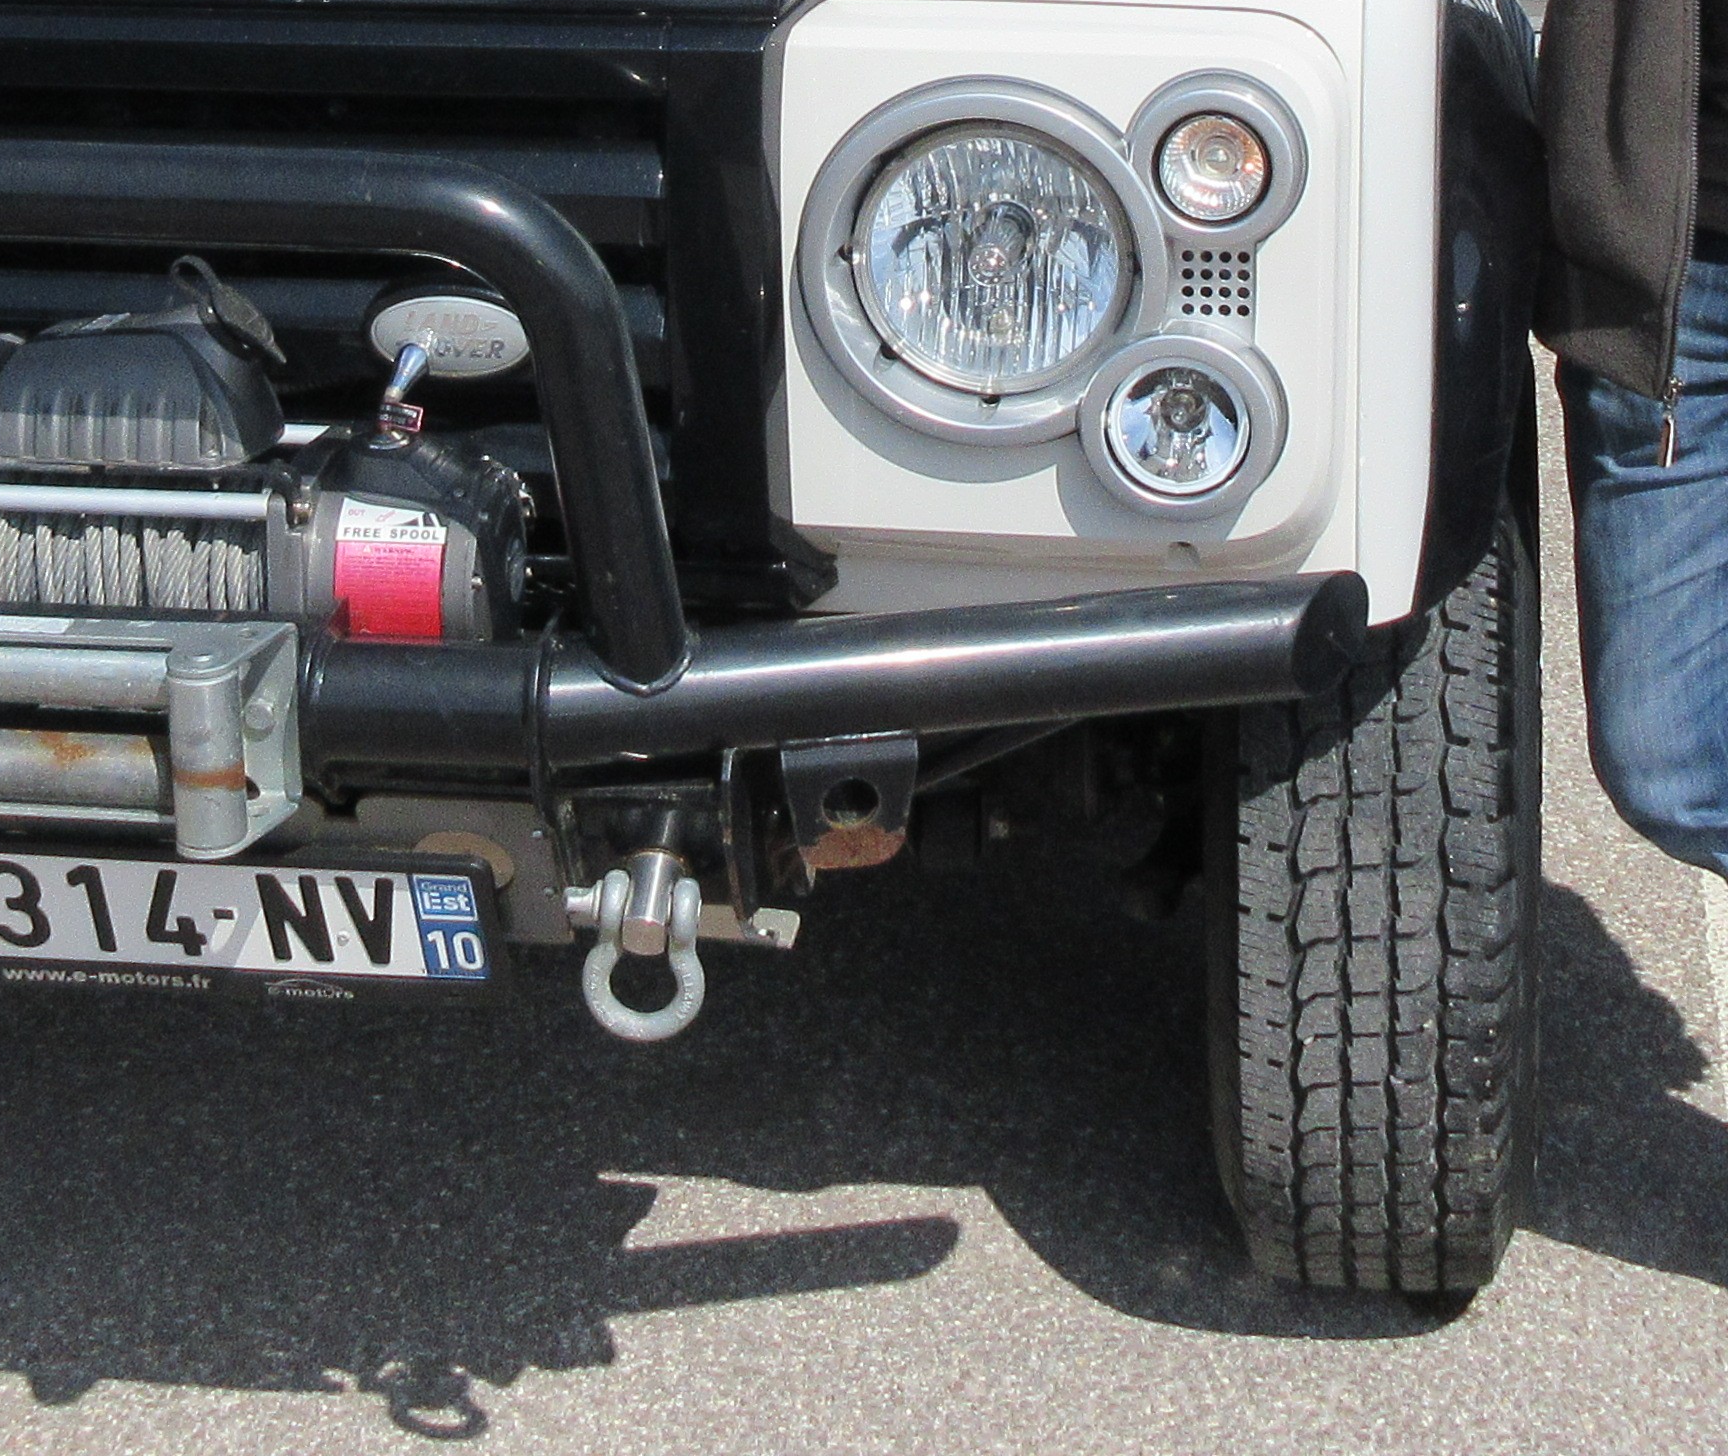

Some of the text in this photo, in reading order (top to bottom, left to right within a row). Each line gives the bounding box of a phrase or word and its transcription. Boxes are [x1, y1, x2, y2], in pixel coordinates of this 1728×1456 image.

[404, 310, 480, 335] LAND
[396, 338, 506, 359] OVER
[348, 508, 365, 517] OUT
[343, 527, 440, 541] FREE SPOOL
[421, 881, 468, 894] Grand
[421, 892, 472, 912] Est
[427, 930, 485, 972] 10
[3, 967, 211, 989] www.e-motors.fr
